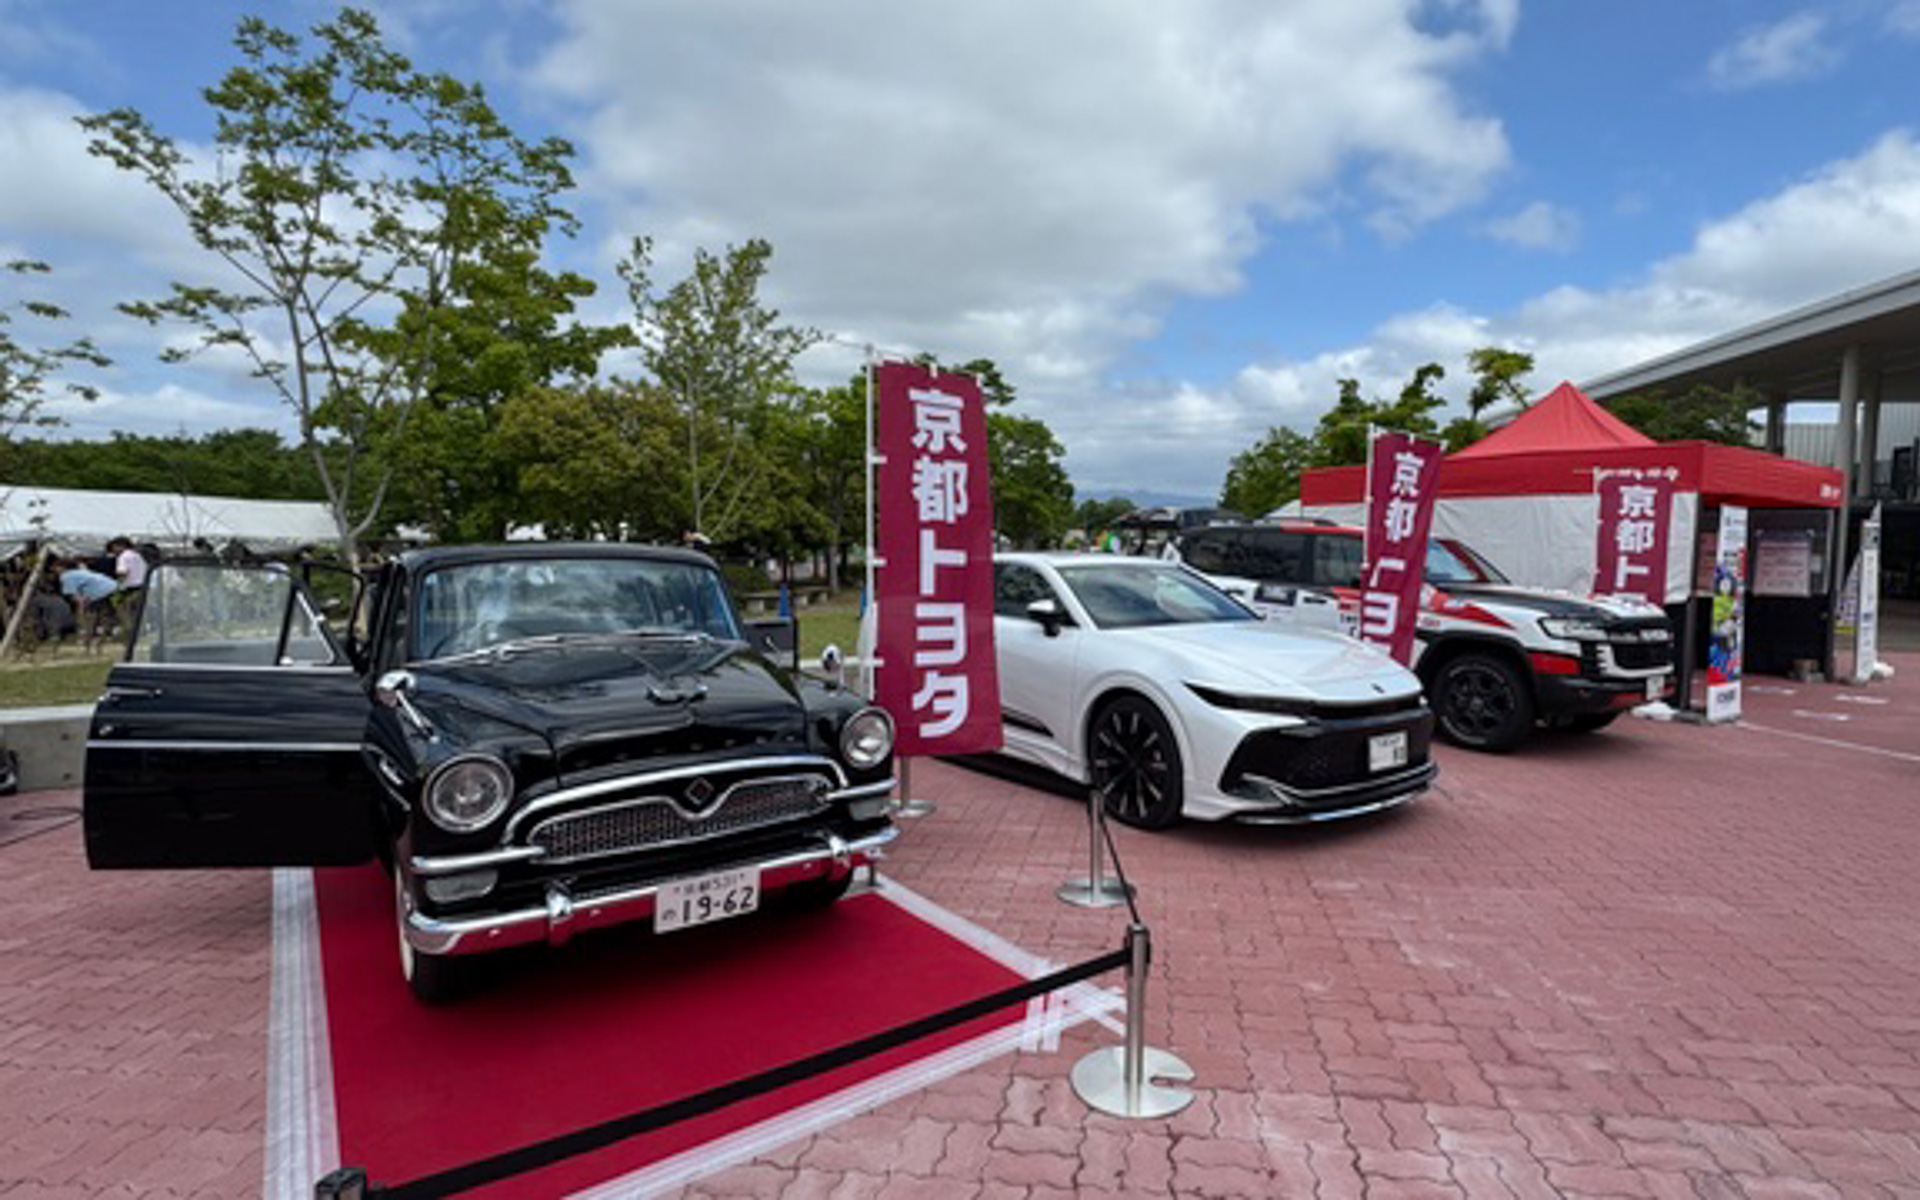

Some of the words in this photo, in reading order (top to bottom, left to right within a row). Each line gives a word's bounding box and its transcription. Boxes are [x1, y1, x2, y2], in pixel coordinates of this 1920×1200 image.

[908, 386, 969, 739] 京都トヨタ
[1363, 451, 1425, 658] 京都トヨ
[1615, 485, 1658, 604] 京都ト
[683, 885, 754, 923] 19-62
